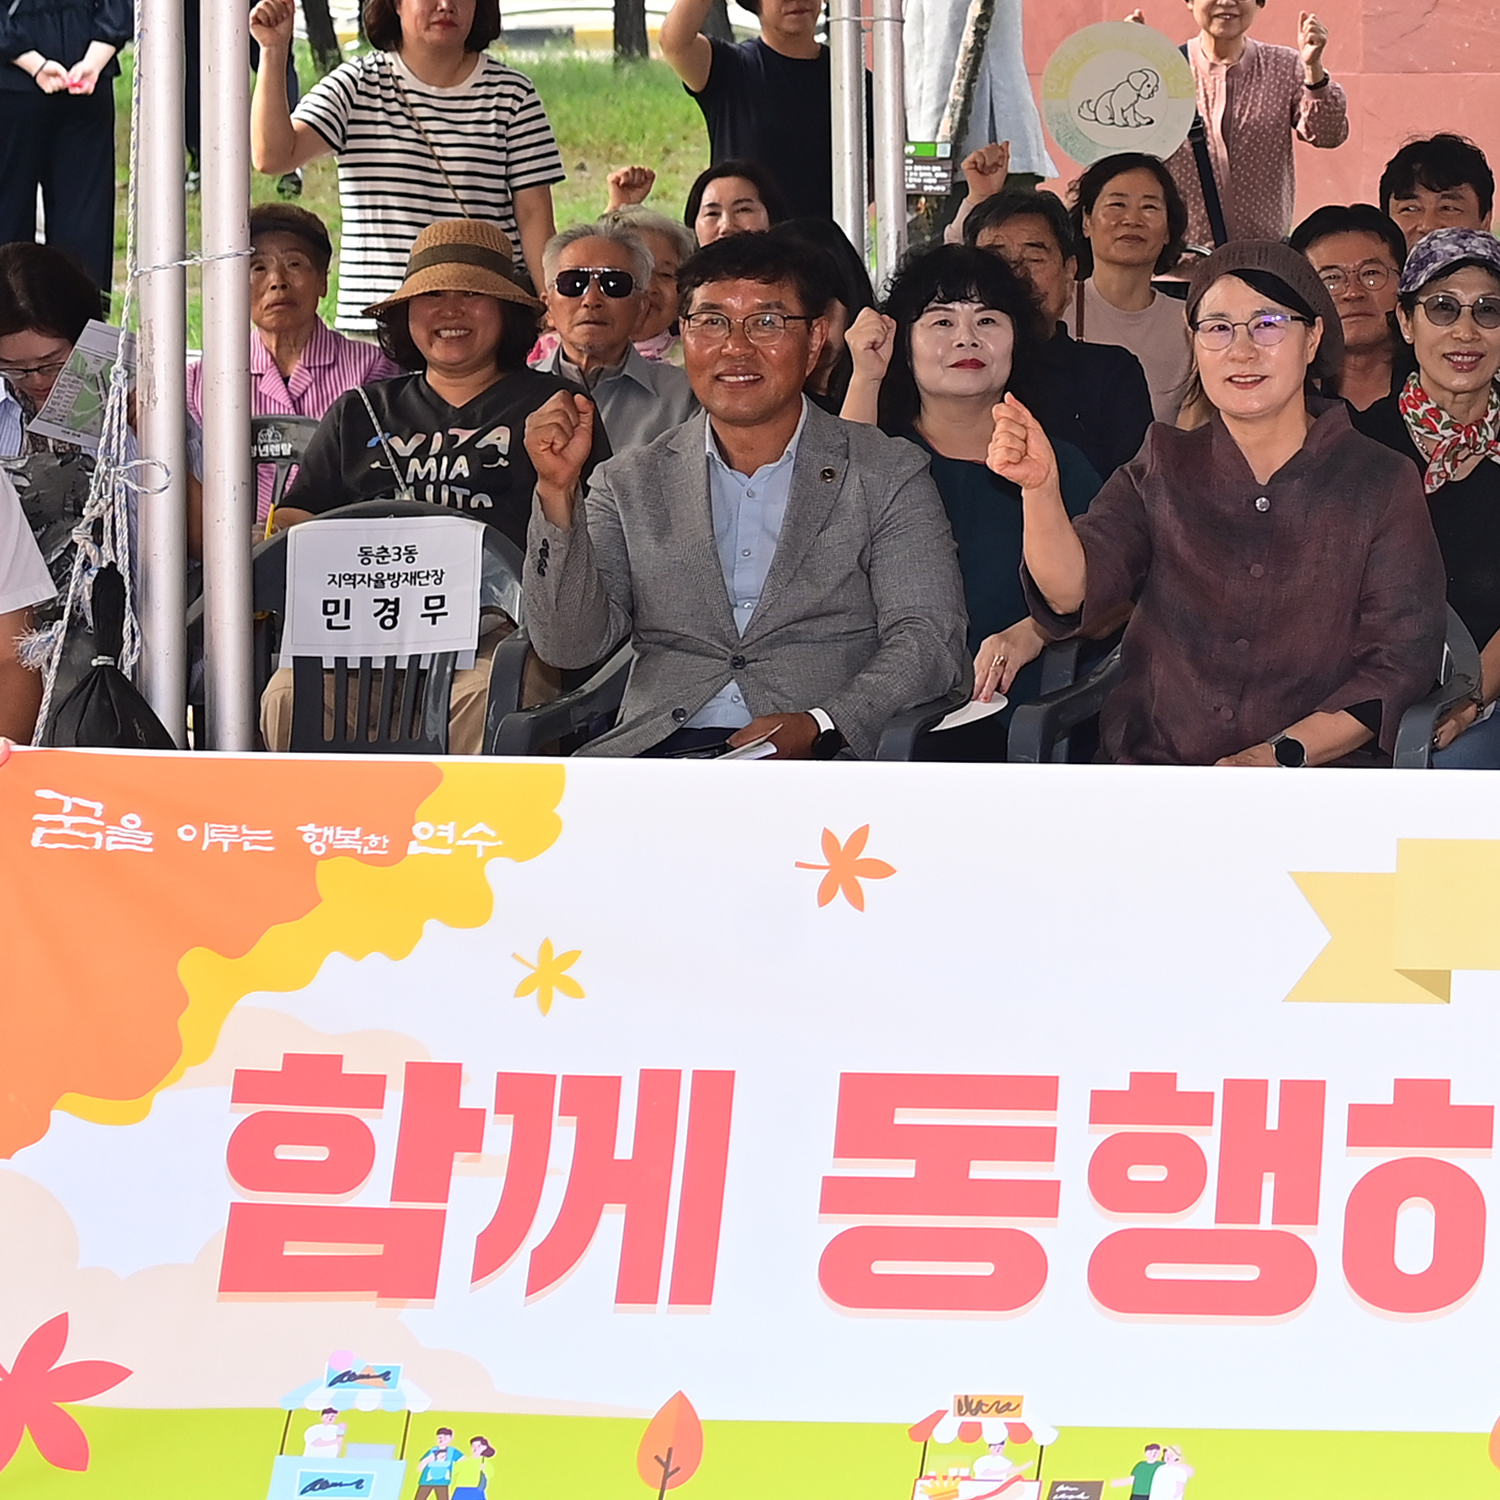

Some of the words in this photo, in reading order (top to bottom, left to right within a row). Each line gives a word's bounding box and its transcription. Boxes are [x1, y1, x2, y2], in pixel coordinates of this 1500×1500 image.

[387, 425, 512, 457] VITA
[405, 454, 470, 484] MIA
[357, 545, 419, 565] 동춘3동
[327, 569, 446, 588] 지역자율방재단장
[31, 789, 154, 852] 꿈을
[177, 822, 275, 853] 이루는
[296, 823, 390, 855] 행복한
[407, 820, 503, 858] 연수
[218, 1053, 736, 1306] 함께
